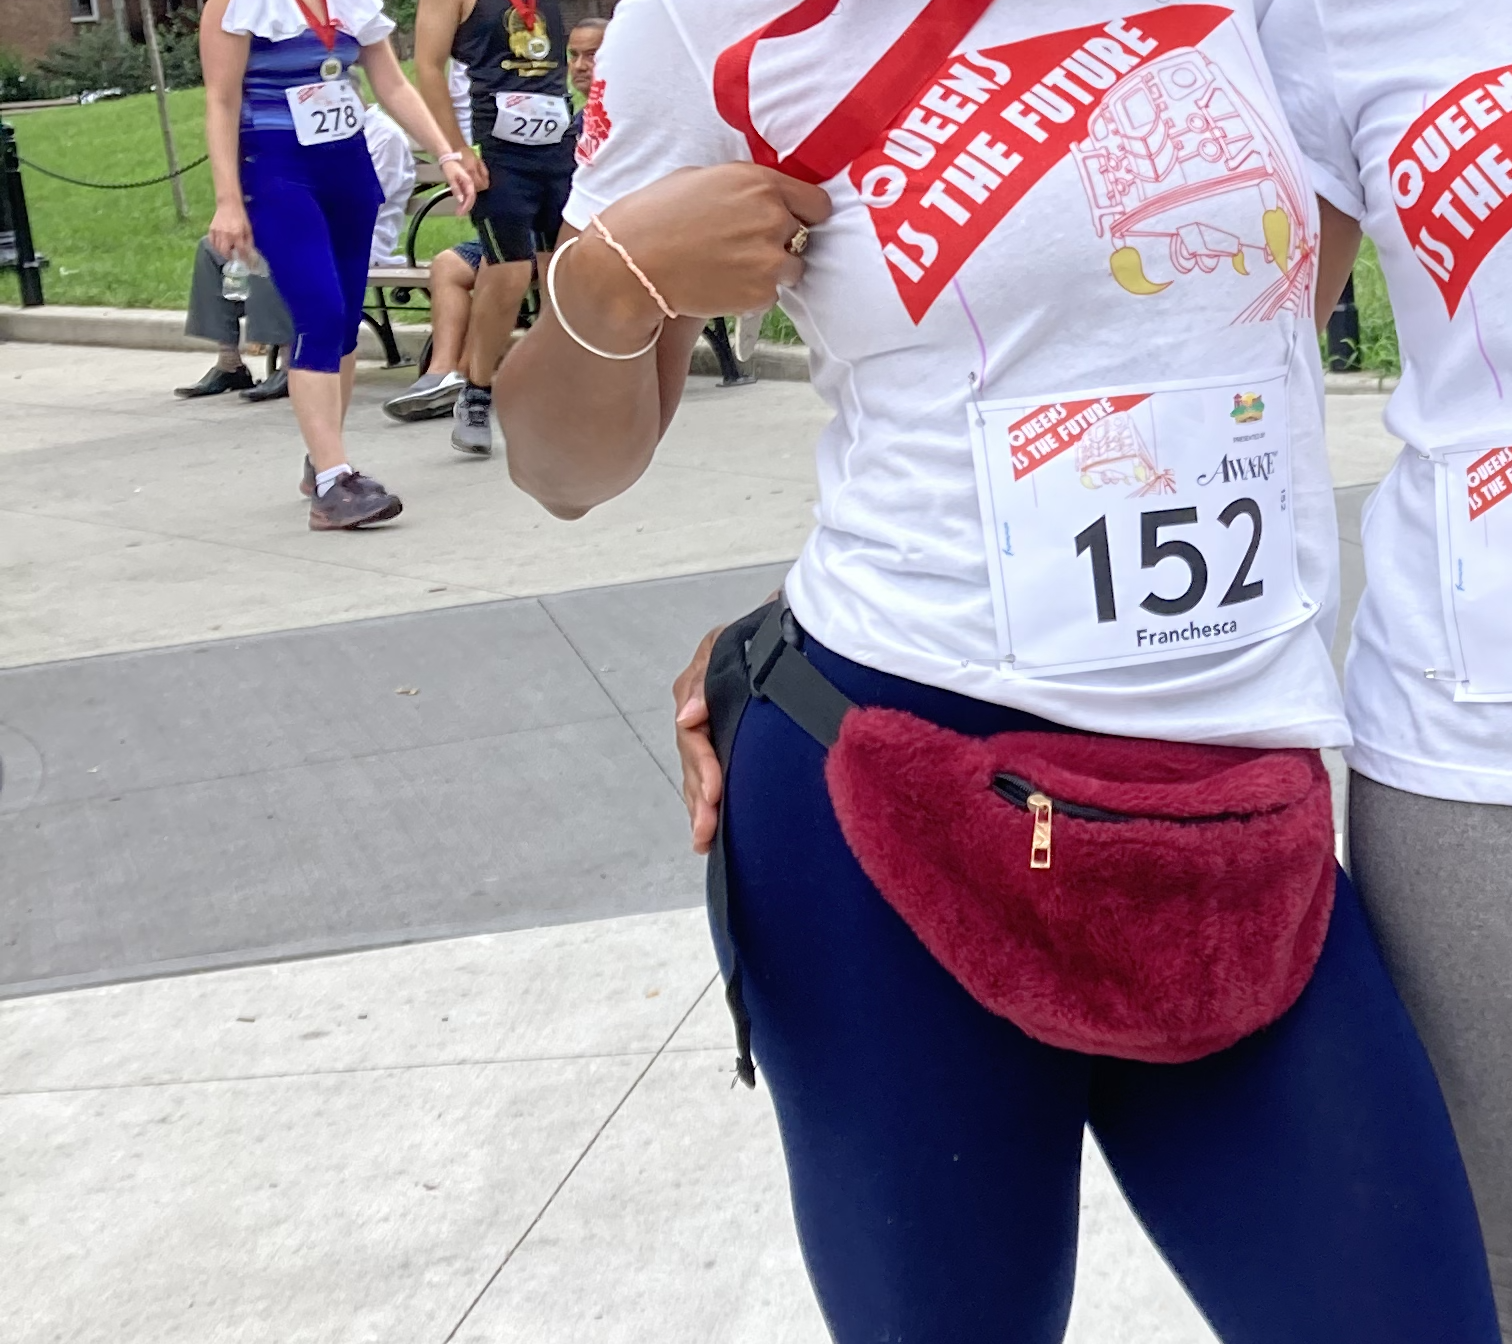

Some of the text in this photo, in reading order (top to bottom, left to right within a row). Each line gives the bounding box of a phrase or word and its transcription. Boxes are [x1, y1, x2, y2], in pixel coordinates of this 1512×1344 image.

[311, 105, 358, 135] 278
[510, 116, 558, 138] 279
[859, 49, 1012, 210] QUEENS
[883, 17, 1160, 283] IS THE FUTURE
[1414, 226, 1456, 283] IS
[1008, 403, 1068, 447] QUEENS
[1010, 397, 1115, 470] IS THE FUTURE
[1196, 452, 1275, 487] AWAKE
[1468, 492, 1483, 511] IS
[1480, 475, 1507, 501] THE
[1074, 497, 1264, 624] 152
[1136, 619, 1238, 647] Franchesca
